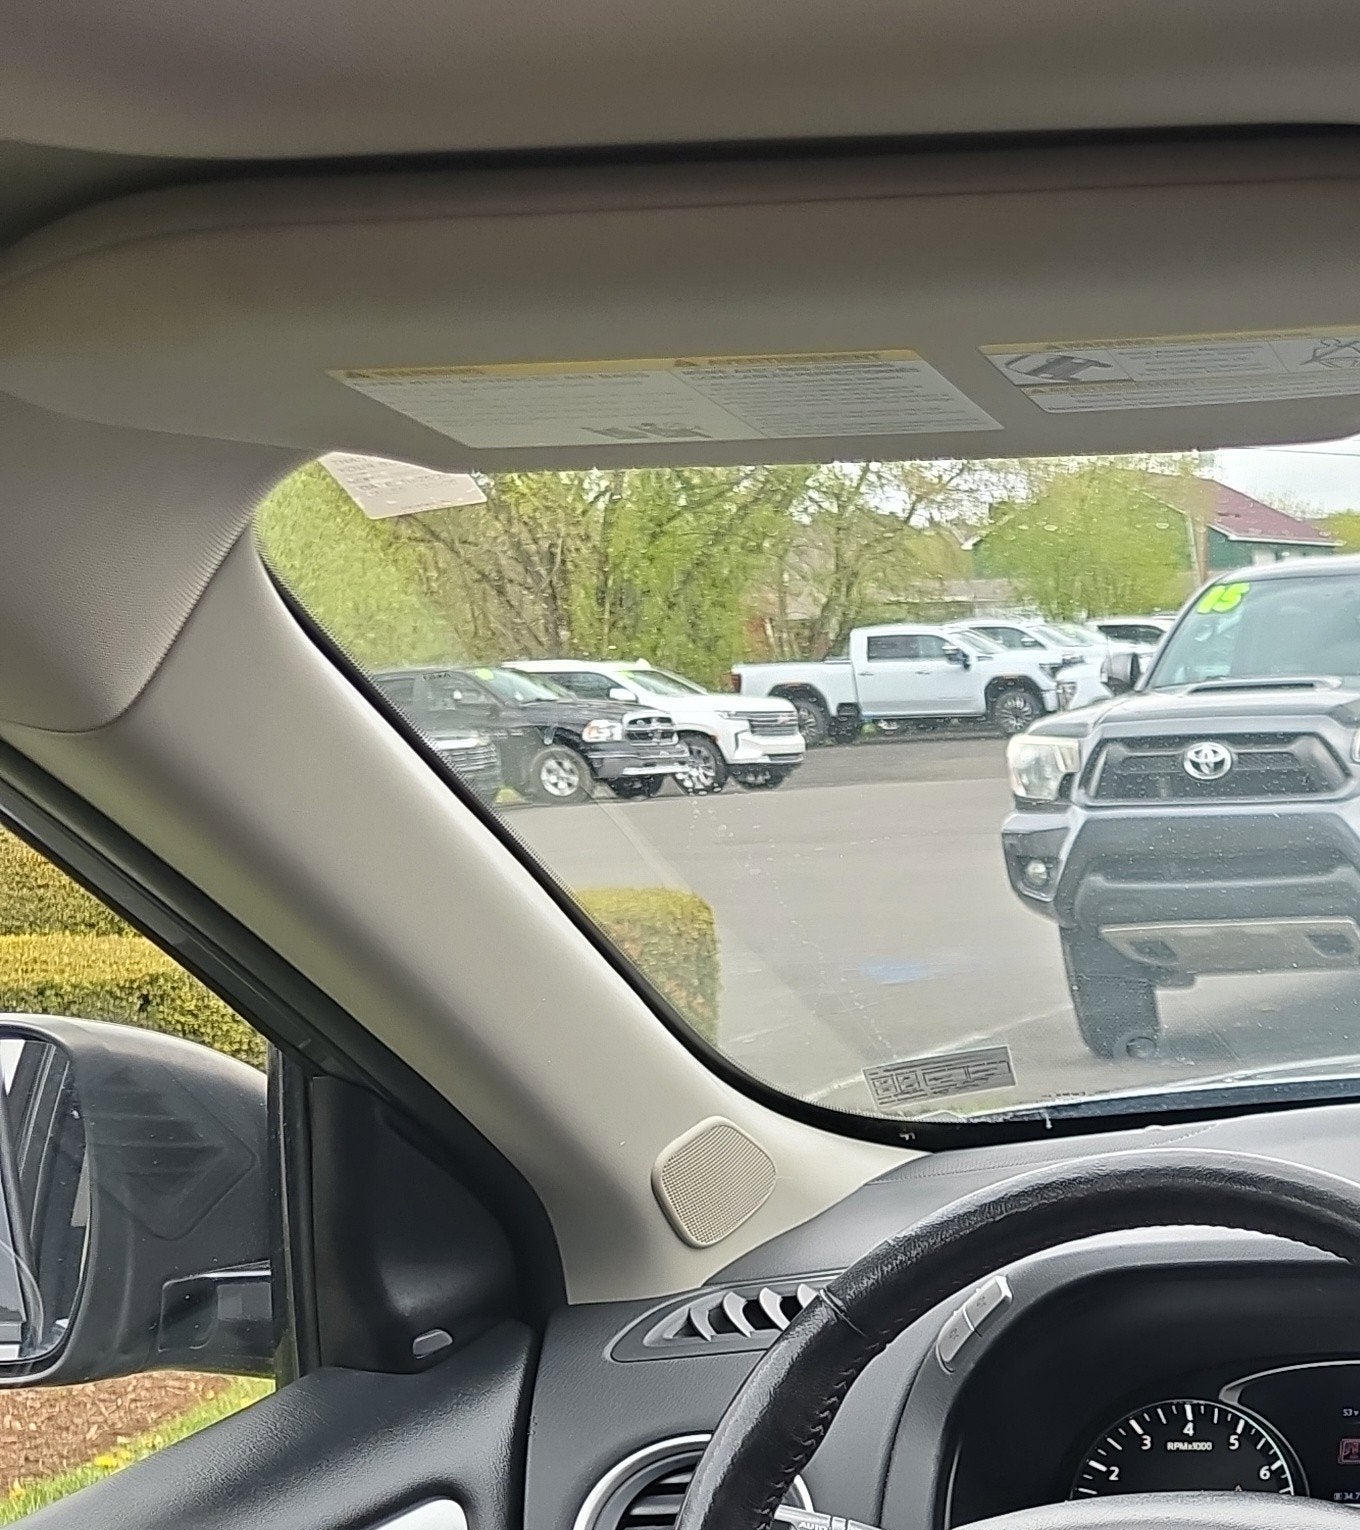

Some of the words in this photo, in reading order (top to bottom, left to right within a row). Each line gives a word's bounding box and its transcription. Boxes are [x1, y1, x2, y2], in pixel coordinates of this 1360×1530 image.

[1183, 1422, 1194, 1436] 4
[1141, 1436, 1151, 1450] 3
[1229, 1436, 1239, 1450] 5
[1109, 1467, 1119, 1480] 2
[1260, 1466, 1270, 1479] 6
